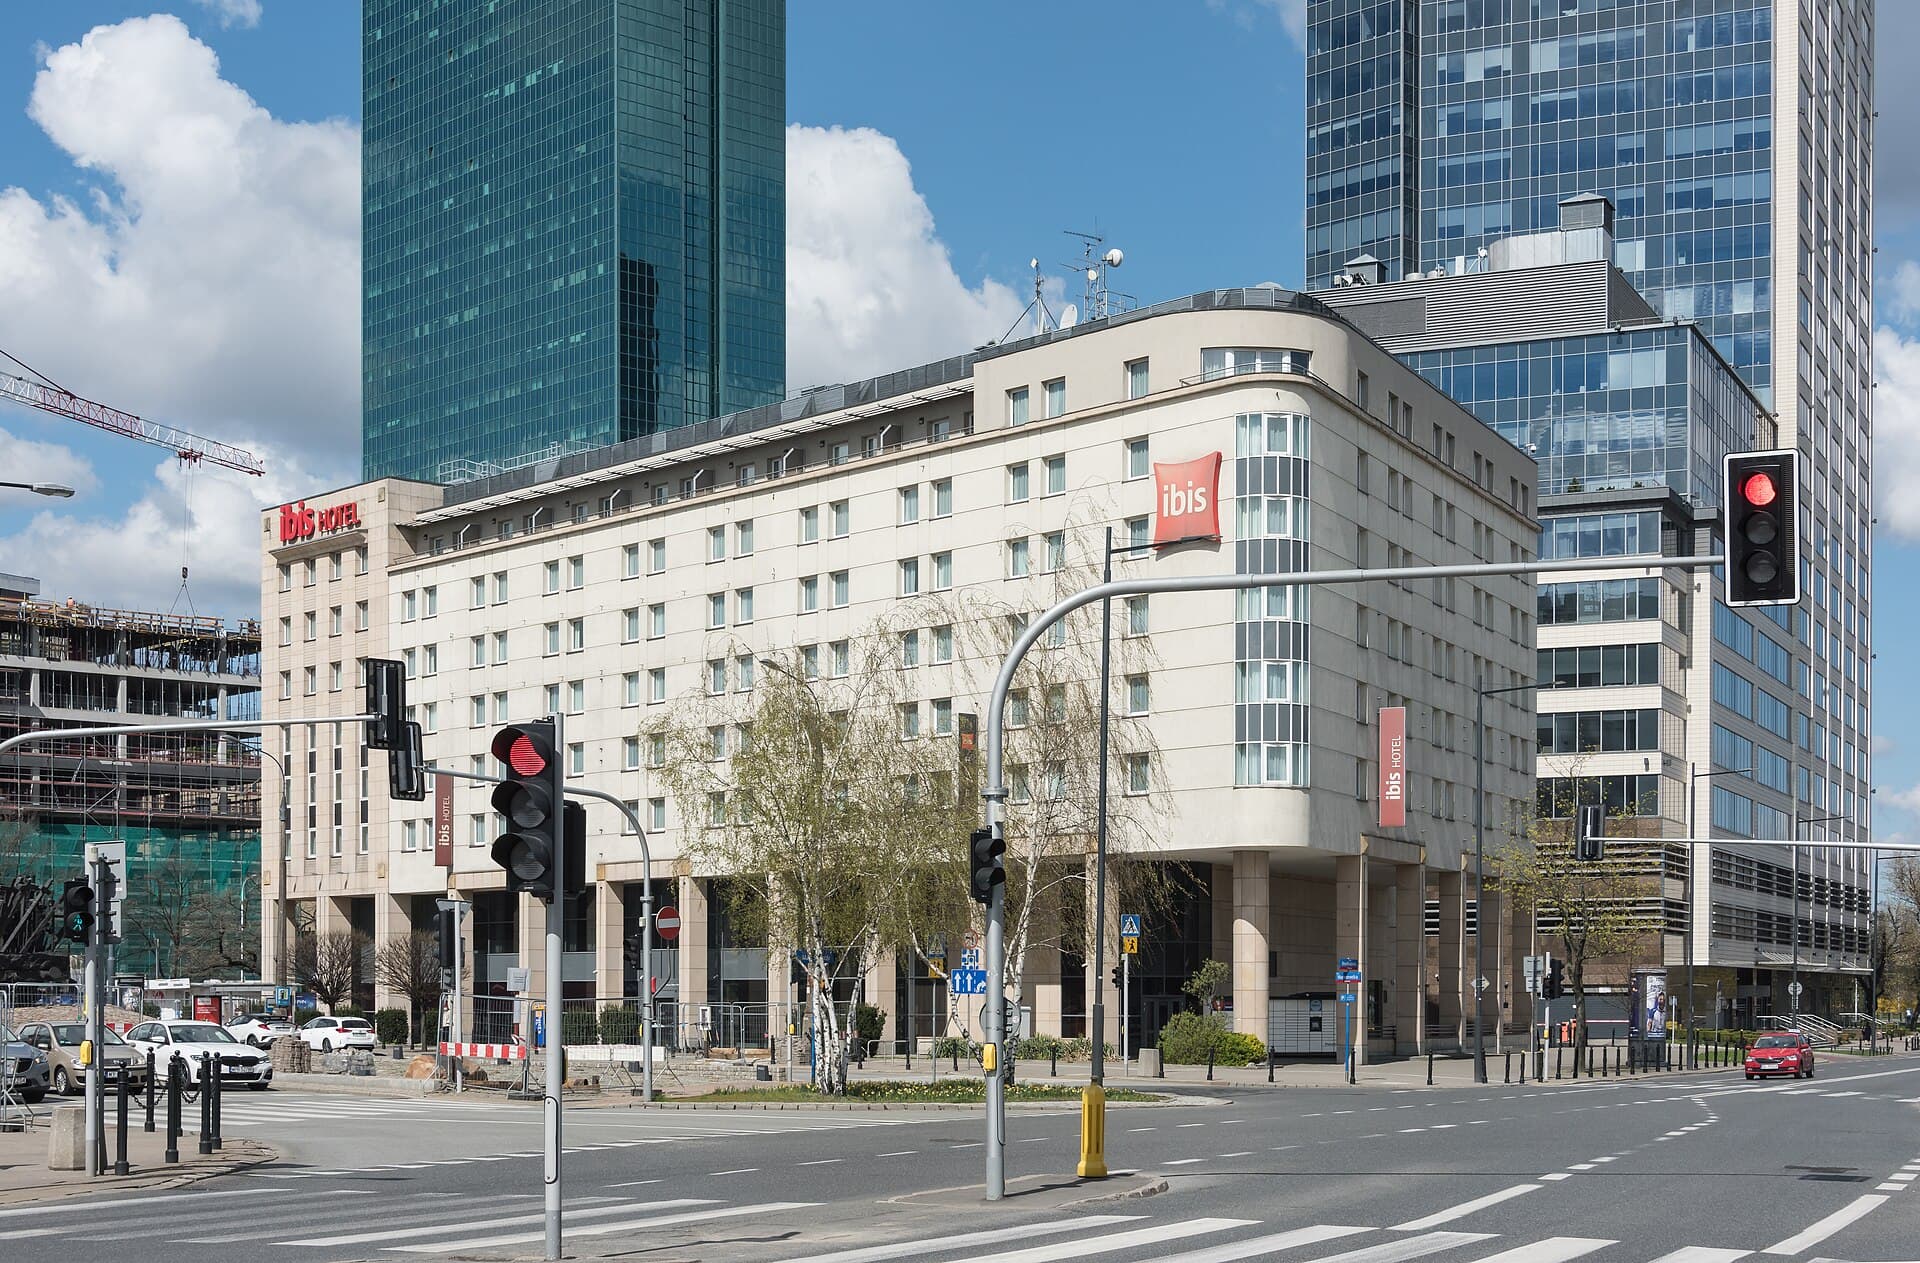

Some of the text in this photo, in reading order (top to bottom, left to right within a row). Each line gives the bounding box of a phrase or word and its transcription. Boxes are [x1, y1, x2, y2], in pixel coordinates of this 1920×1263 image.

[1163, 481, 1207, 517] ibis
[280, 500, 358, 541] ibis HOTEL
[1386, 735, 1400, 800] ibis HOTEL
[439, 824, 450, 846] ibis
